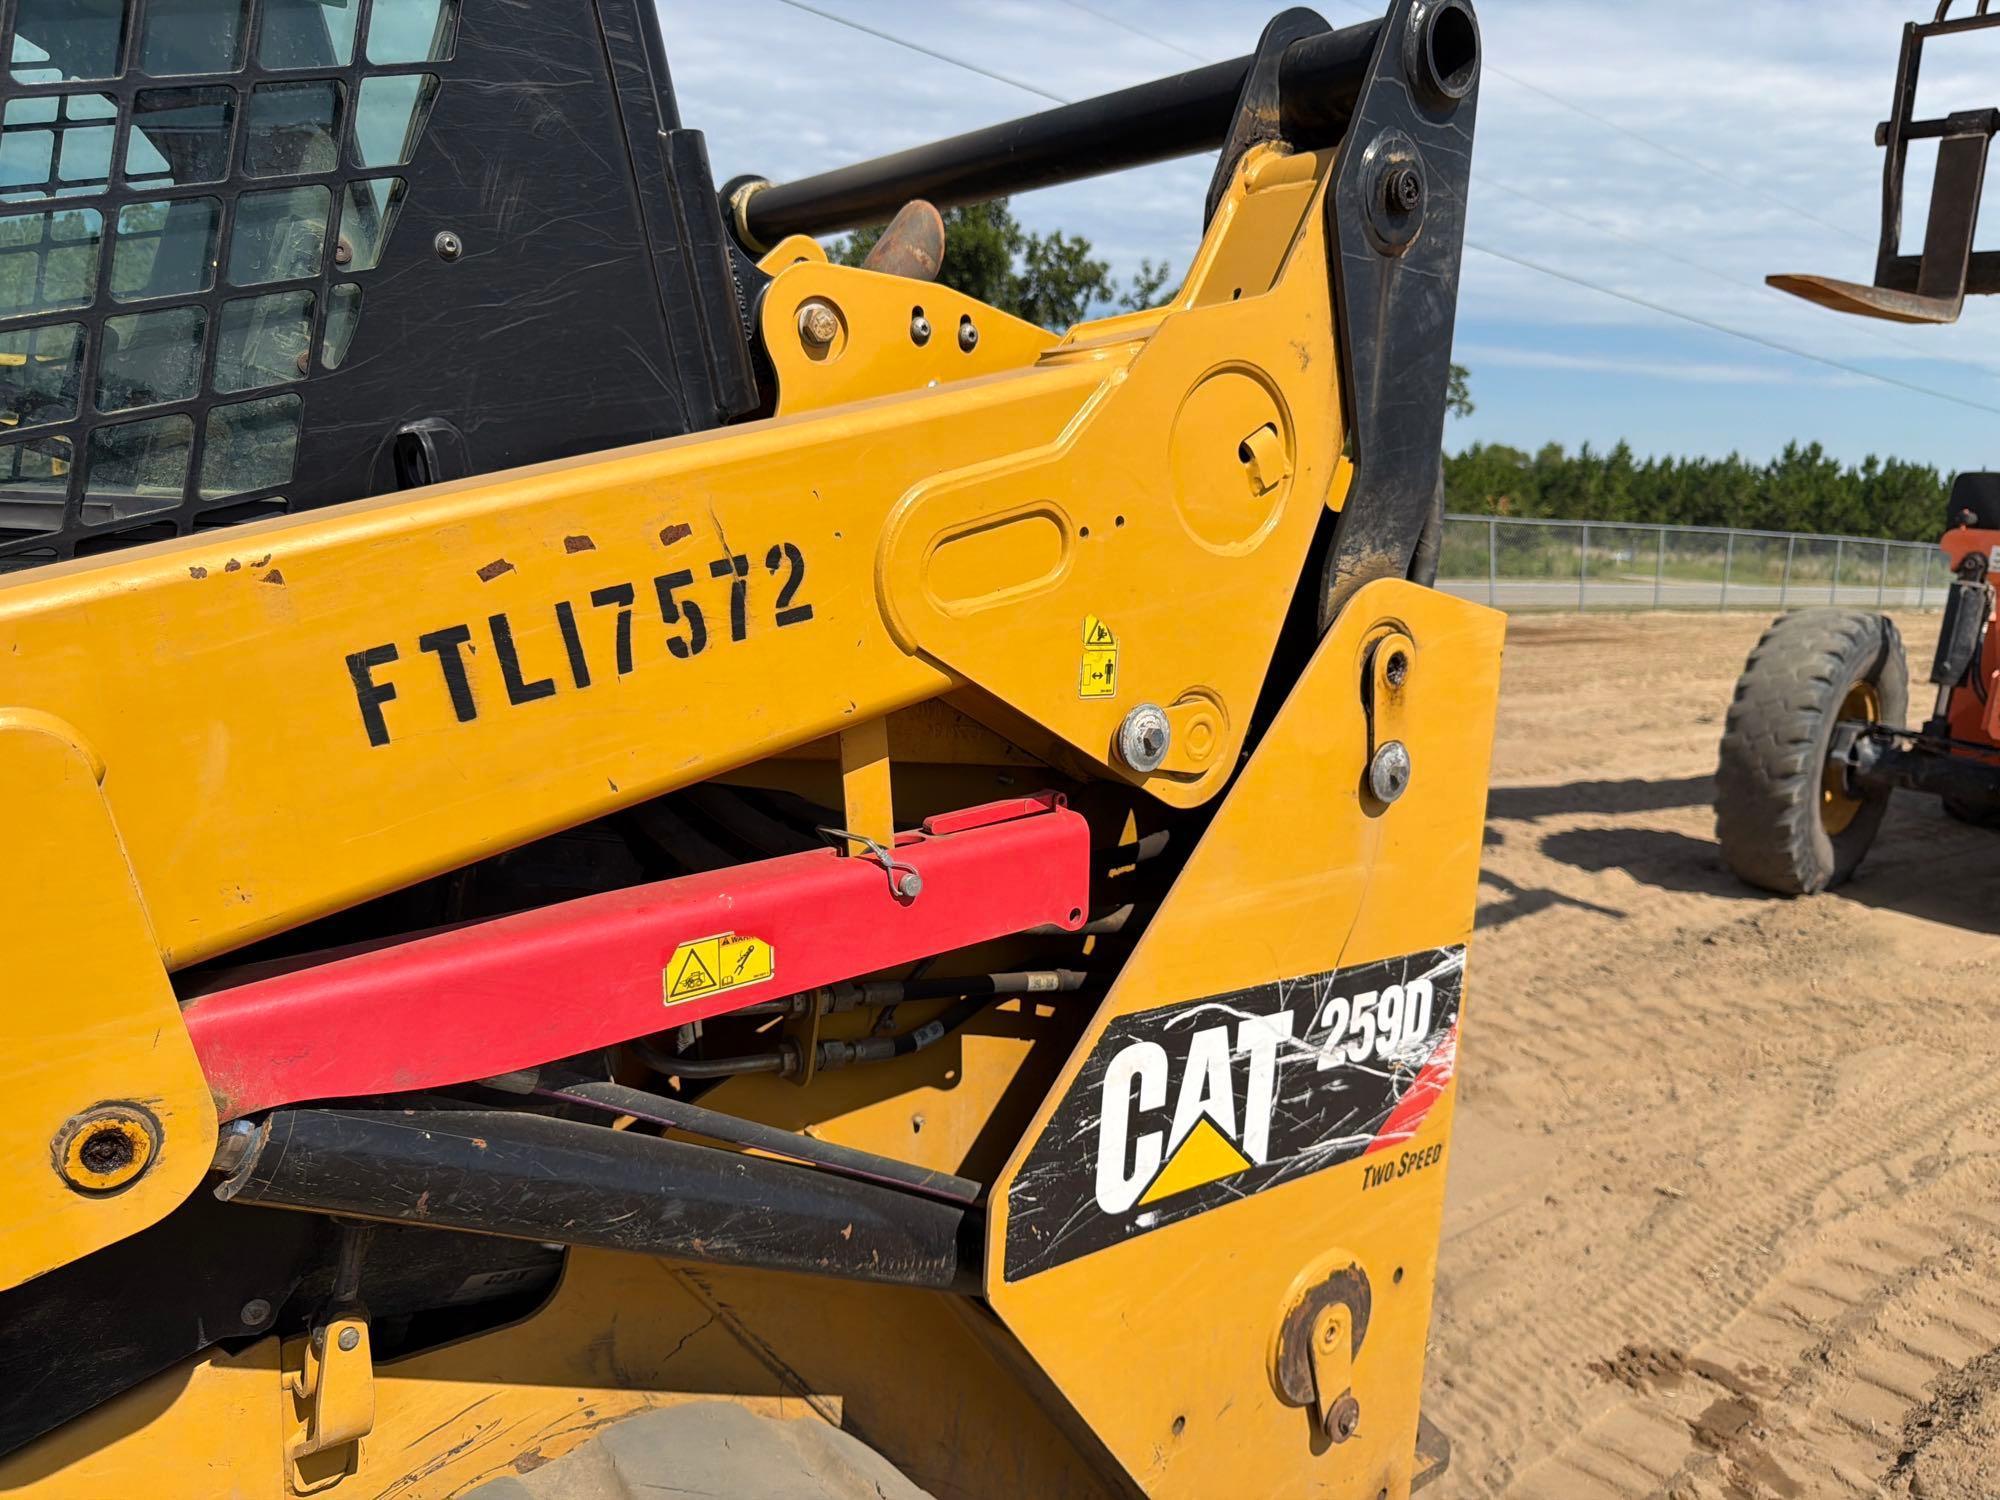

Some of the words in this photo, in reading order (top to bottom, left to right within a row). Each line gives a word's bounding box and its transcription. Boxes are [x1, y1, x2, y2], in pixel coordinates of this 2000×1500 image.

[346, 541, 814, 747] FTL17572
[1095, 1009, 1294, 1215] CAT
[1316, 979, 1434, 1072] 259D
